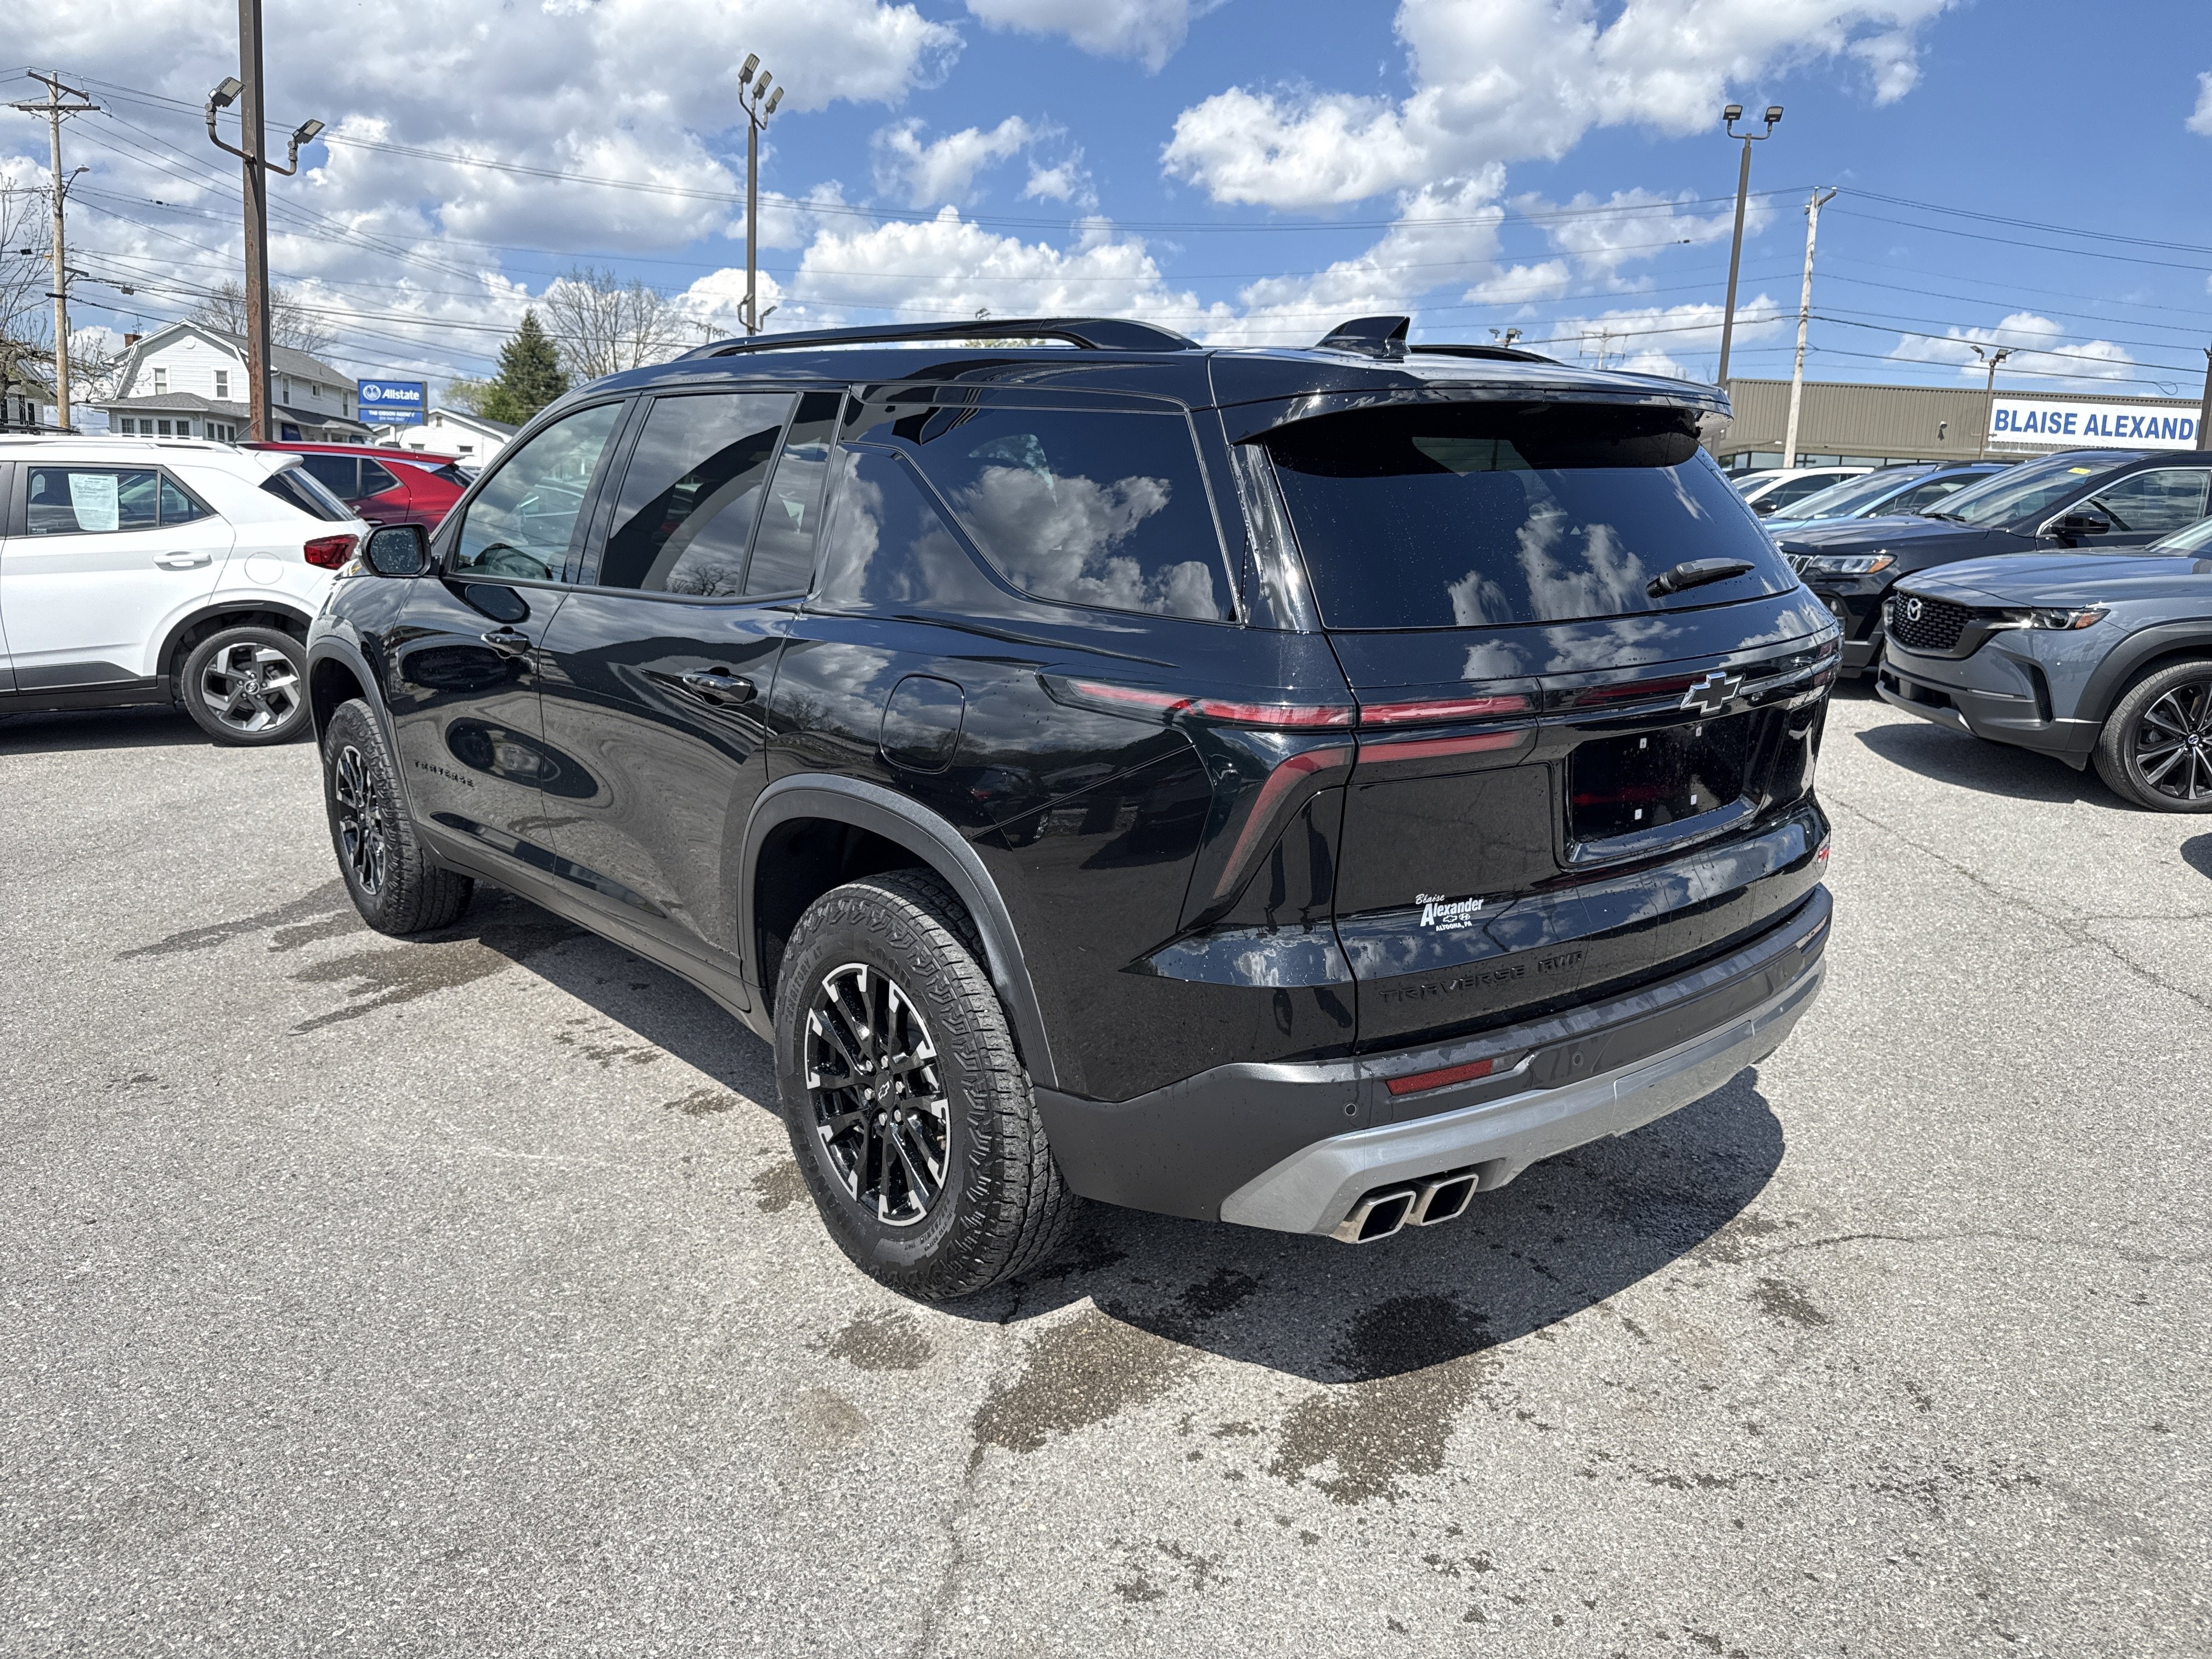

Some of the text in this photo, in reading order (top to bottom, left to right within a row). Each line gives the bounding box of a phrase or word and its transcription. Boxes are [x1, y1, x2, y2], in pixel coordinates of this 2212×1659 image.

[382, 388, 420, 400] Allstate
[1994, 409, 2078, 435] BLAISE
[1415, 894, 1445, 905] Blaise
[1420, 898, 1484, 927] Alexander
[1436, 923, 1464, 932] ALTOONA,
[1379, 964, 1525, 1002] TRAVERSE
